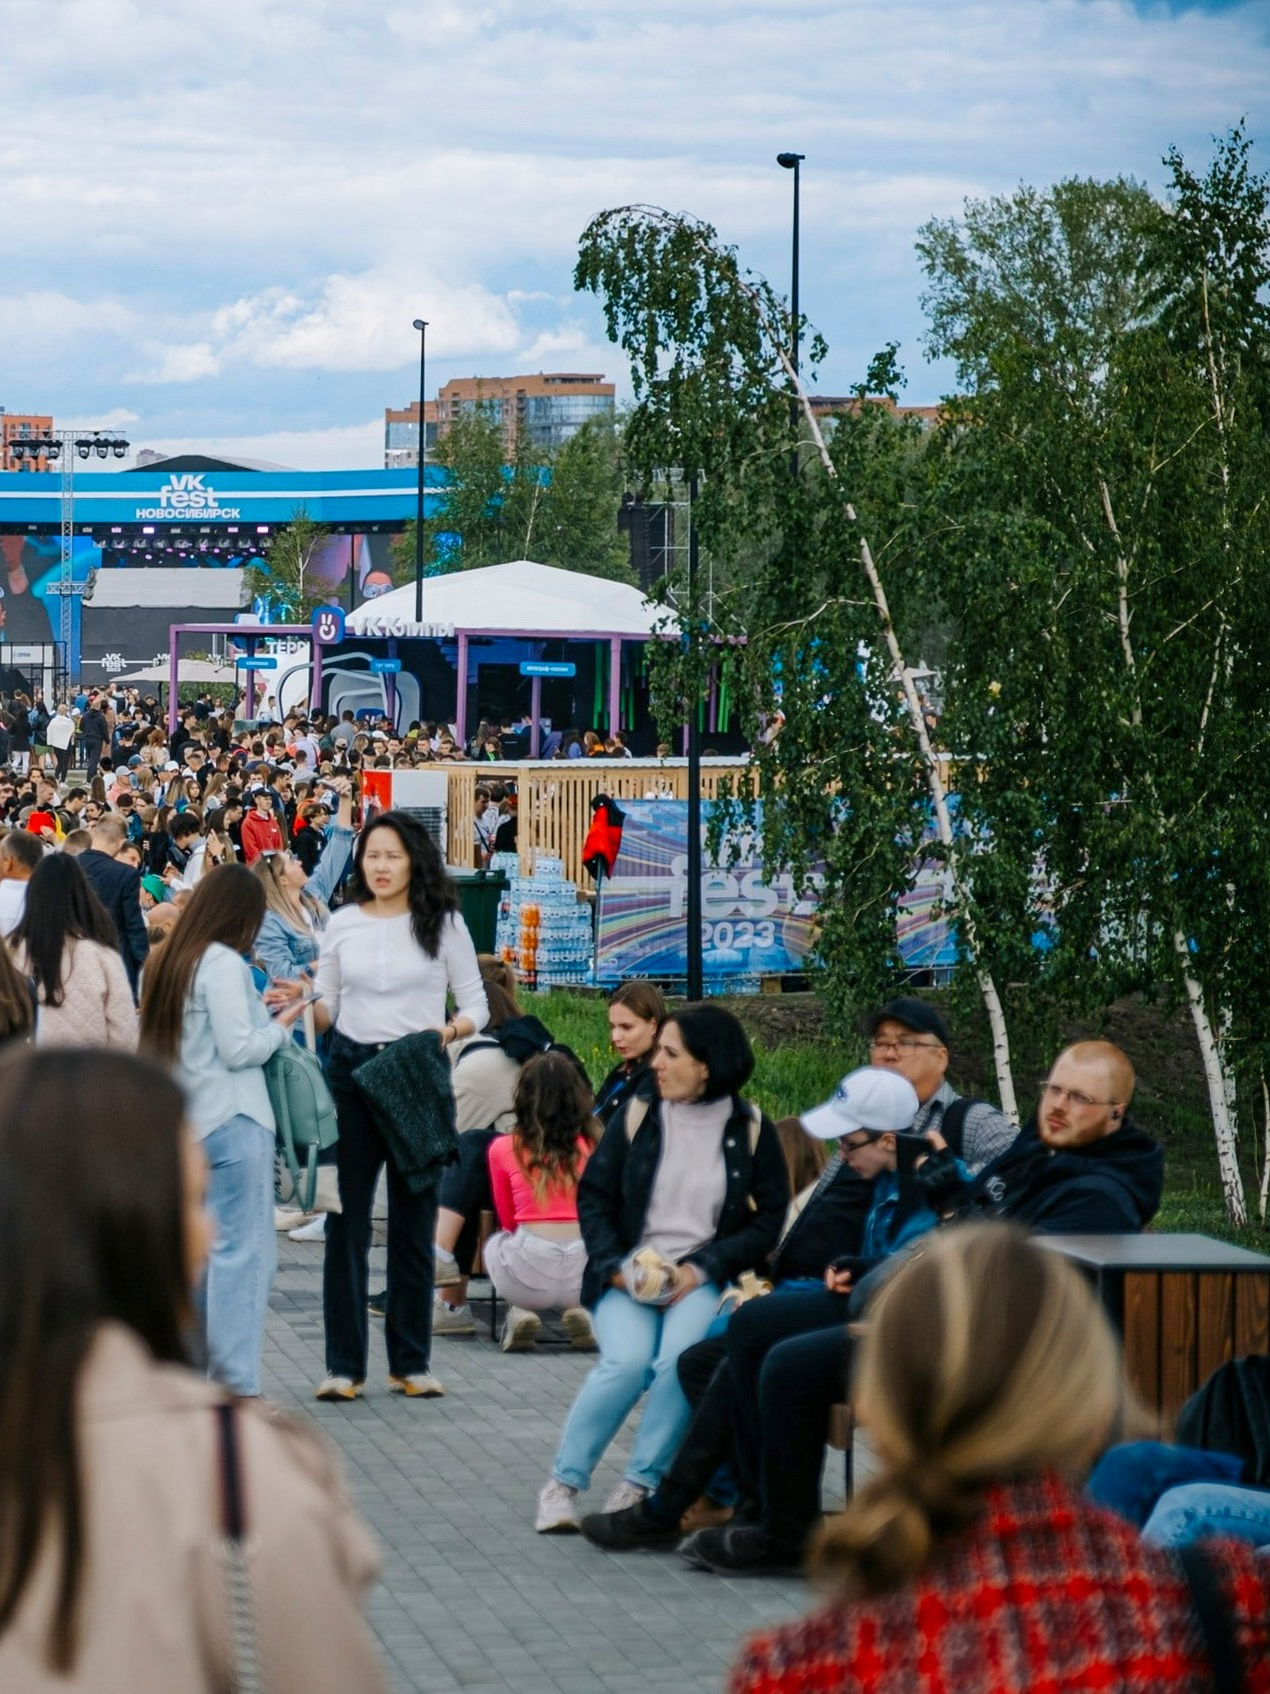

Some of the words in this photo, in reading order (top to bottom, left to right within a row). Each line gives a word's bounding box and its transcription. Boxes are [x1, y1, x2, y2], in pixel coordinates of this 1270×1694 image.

[169, 474, 206, 490] VK
[160, 485, 218, 507] fest
[135, 508, 241, 519] НОВОСИБИРСК
[353, 617, 382, 636] VK
[385, 617, 455, 637] Клипы
[701, 921, 775, 948] 2023
